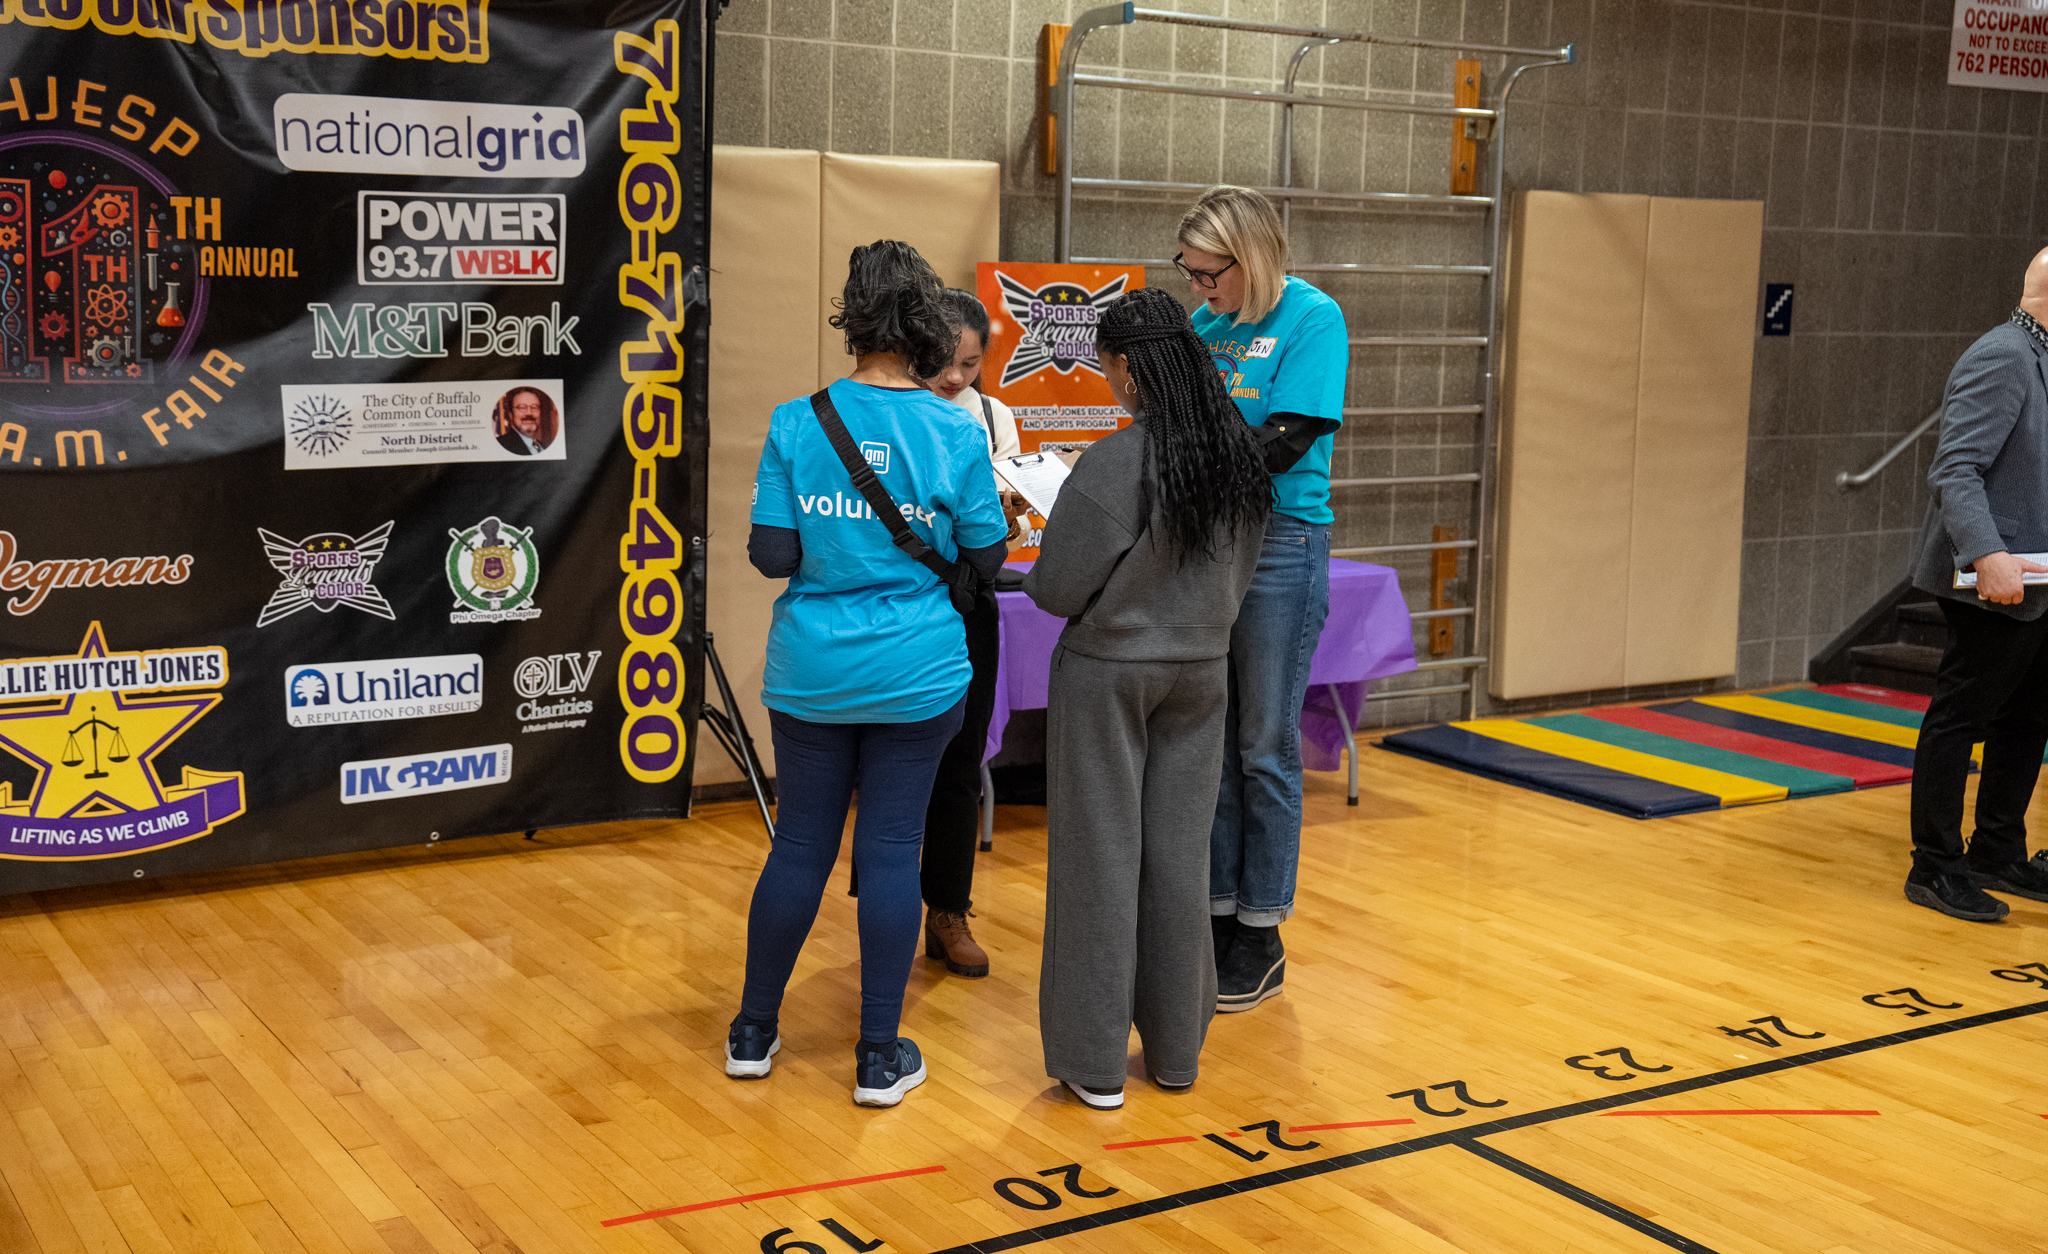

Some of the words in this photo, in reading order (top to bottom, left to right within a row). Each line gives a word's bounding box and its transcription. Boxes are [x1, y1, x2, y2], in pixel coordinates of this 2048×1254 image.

[205, 0, 483, 56] Sponsors!
[1970, 34, 1992, 48] NOT
[1996, 36, 2010, 50] TO
[1958, 52, 1984, 72] 762
[281, 109, 580, 172] nationalgrid
[170, 197, 221, 240] TH
[369, 200, 557, 241] POWER
[84, 254, 128, 282] TH
[200, 246, 298, 278] ANNUAL
[369, 246, 448, 278] 93.7
[456, 250, 554, 275] WBLK
[1030, 302, 1096, 322] SPORTS
[307, 302, 458, 358] M&T
[461, 301, 582, 358] Bank
[1230, 372, 1244, 386] TH
[1230, 388, 1260, 399] ANNUAL
[142, 349, 246, 446] FAIR
[363, 394, 388, 407] The
[392, 394, 416, 408] City
[420, 392, 434, 405] of
[436, 391, 481, 405] Buffalo
[363, 408, 421, 421] Common
[425, 405, 472, 418] Council
[618, 24, 683, 778] 716-715-4980
[1030, 408, 1058, 416] HUTCH
[1060, 408, 1086, 416] JONES
[1088, 408, 1129, 416] EDUCATIO
[381, 435, 416, 446] North
[420, 434, 462, 444] District
[1023, 420, 1041, 429] AND
[1043, 420, 1074, 428] SPORTS
[1076, 420, 1116, 428] PROGRAM
[864, 448, 885, 466] gm
[0, 531, 194, 616] egmans
[280, 560, 372, 589] Legends
[292, 551, 360, 569] SPORTS
[302, 588, 315, 598] OF
[318, 582, 364, 598] COLOR
[470, 612, 502, 622] Omega
[505, 609, 540, 620] Chapter
[0, 666, 47, 694] LIE
[54, 660, 138, 690] HUTCH
[145, 654, 220, 684] JONES
[336, 663, 480, 704] Uniland
[514, 650, 602, 698] OLV
[292, 715, 302, 725] A
[308, 708, 394, 724] REPUTATION
[400, 706, 424, 717] FOR
[430, 700, 480, 714] RESULTS
[516, 697, 593, 721] Charities
[346, 752, 496, 797] INGRAM
[501, 750, 509, 776] MICRO
[10, 828, 76, 845] LIFTING
[78, 828, 104, 845] AS
[106, 824, 136, 842] WE
[137, 810, 190, 836] CLIMB
[1862, 987, 1964, 1018] 25
[1716, 1015, 1826, 1048] 24
[1564, 1046, 1674, 1082] 23
[1386, 1080, 1509, 1118] 22
[1202, 1120, 1321, 1163] 21
[993, 1163, 1119, 1212] 20
